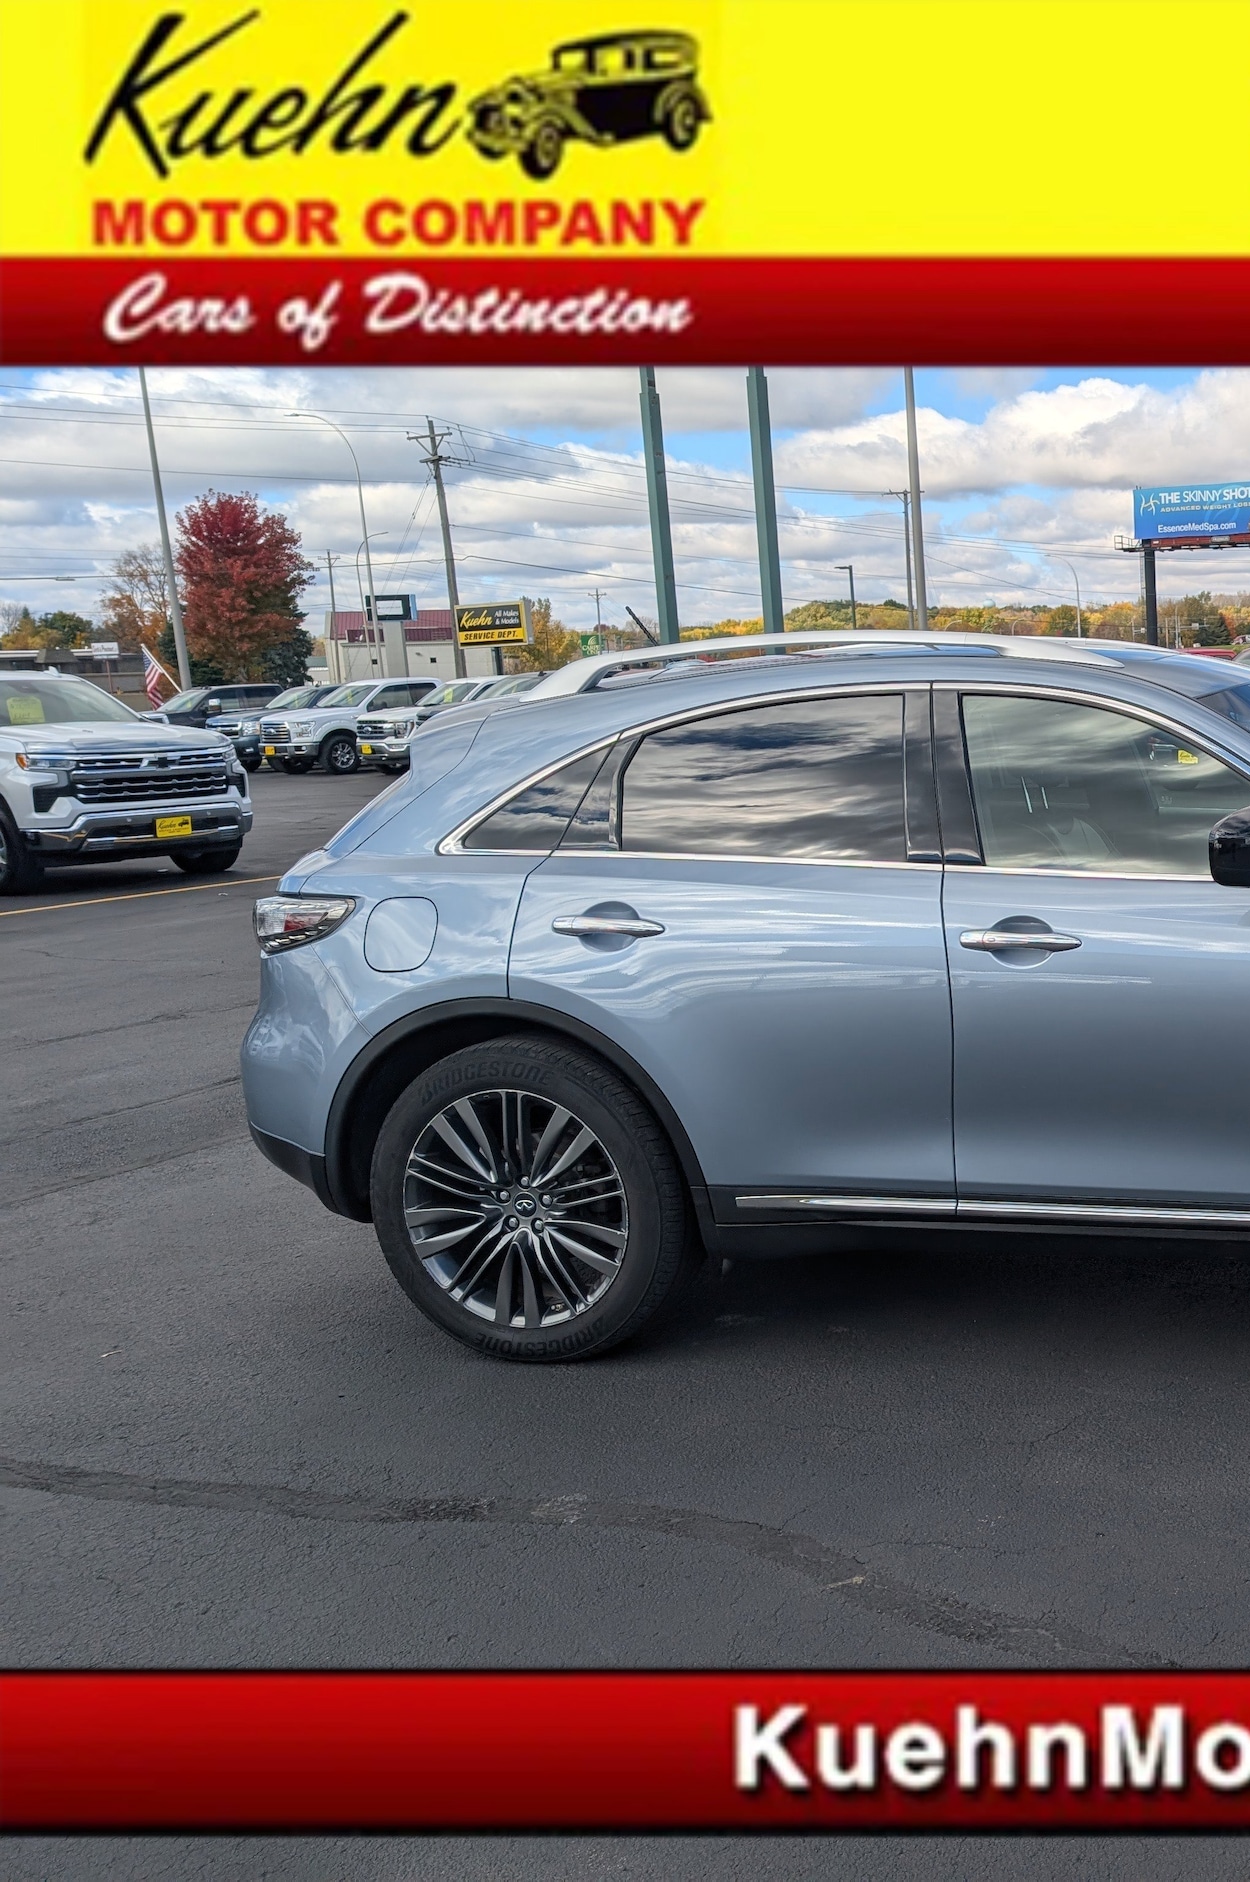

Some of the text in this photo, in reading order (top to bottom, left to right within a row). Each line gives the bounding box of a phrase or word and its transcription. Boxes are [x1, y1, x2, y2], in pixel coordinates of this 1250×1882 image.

[1159, 492, 1181, 505] THE
[1182, 489, 1222, 503] SKINNY
[1160, 505, 1202, 513] ADVANCED
[1202, 503, 1232, 511] WEIGHT
[1157, 522, 1237, 534] EssenceMedSpa.com
[460, 609, 492, 629] Kuehn
[501, 617, 519, 625] Models
[464, 629, 519, 641] SERVICE DEPT.
[158, 819, 177, 830] Kuehn
[420, 1060, 554, 1105] BRIDGESTONE
